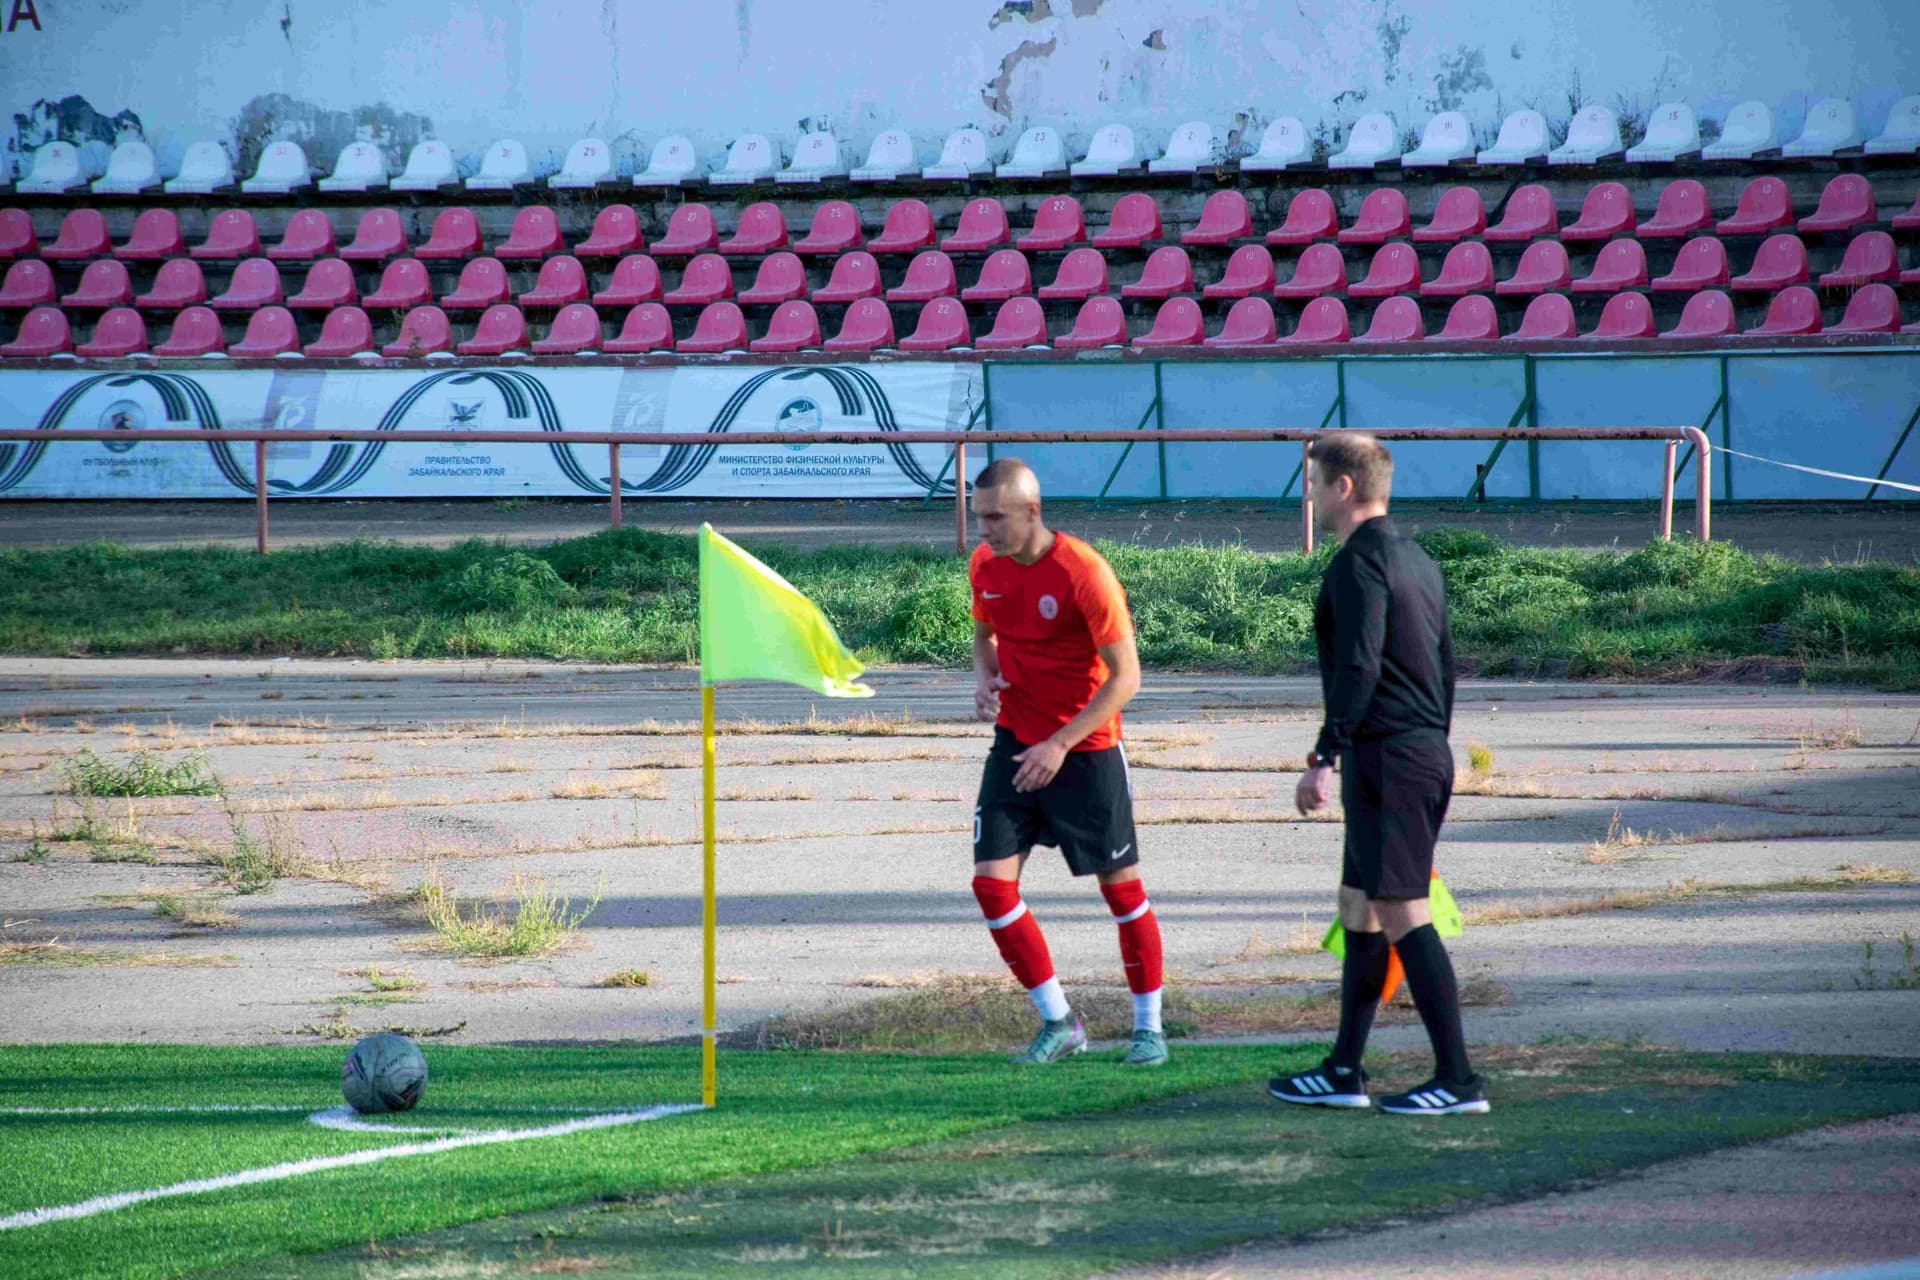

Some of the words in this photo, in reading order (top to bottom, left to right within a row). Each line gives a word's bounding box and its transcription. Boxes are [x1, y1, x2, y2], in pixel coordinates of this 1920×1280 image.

[0, 0, 41, 32] А
[1669, 111, 1678, 120] 15
[1519, 117, 1529, 128] 17
[887, 135, 897, 145] 25
[962, 136, 972, 145] 24
[746, 142, 757, 151] 27
[1603, 190, 1613, 200] 15
[1054, 200, 1065, 211] 22
[1391, 249, 1400, 259] 17
[937, 304, 951, 314] 22
[1321, 304, 1329, 313] 17
[571, 311, 582, 321] 27
[425, 456, 491, 464] ПРАВИТЕЛЬСТВО
[718, 455, 783, 464] МИНИСТЕРСТВО
[785, 454, 841, 464] ФИЗИЧЕСКОЙ
[842, 455, 884, 464] КУЛЬТУРЫ
[408, 467, 482, 476] ЗАБАЙКАЛЬСКОГО
[483, 467, 505, 476] КРАЯ
[732, 467, 738, 476] И
[740, 467, 771, 476] СПОРТА
[773, 466, 847, 476] ЗАБАЙКАЛЬСКОГО
[849, 467, 871, 476] КРАЯ
